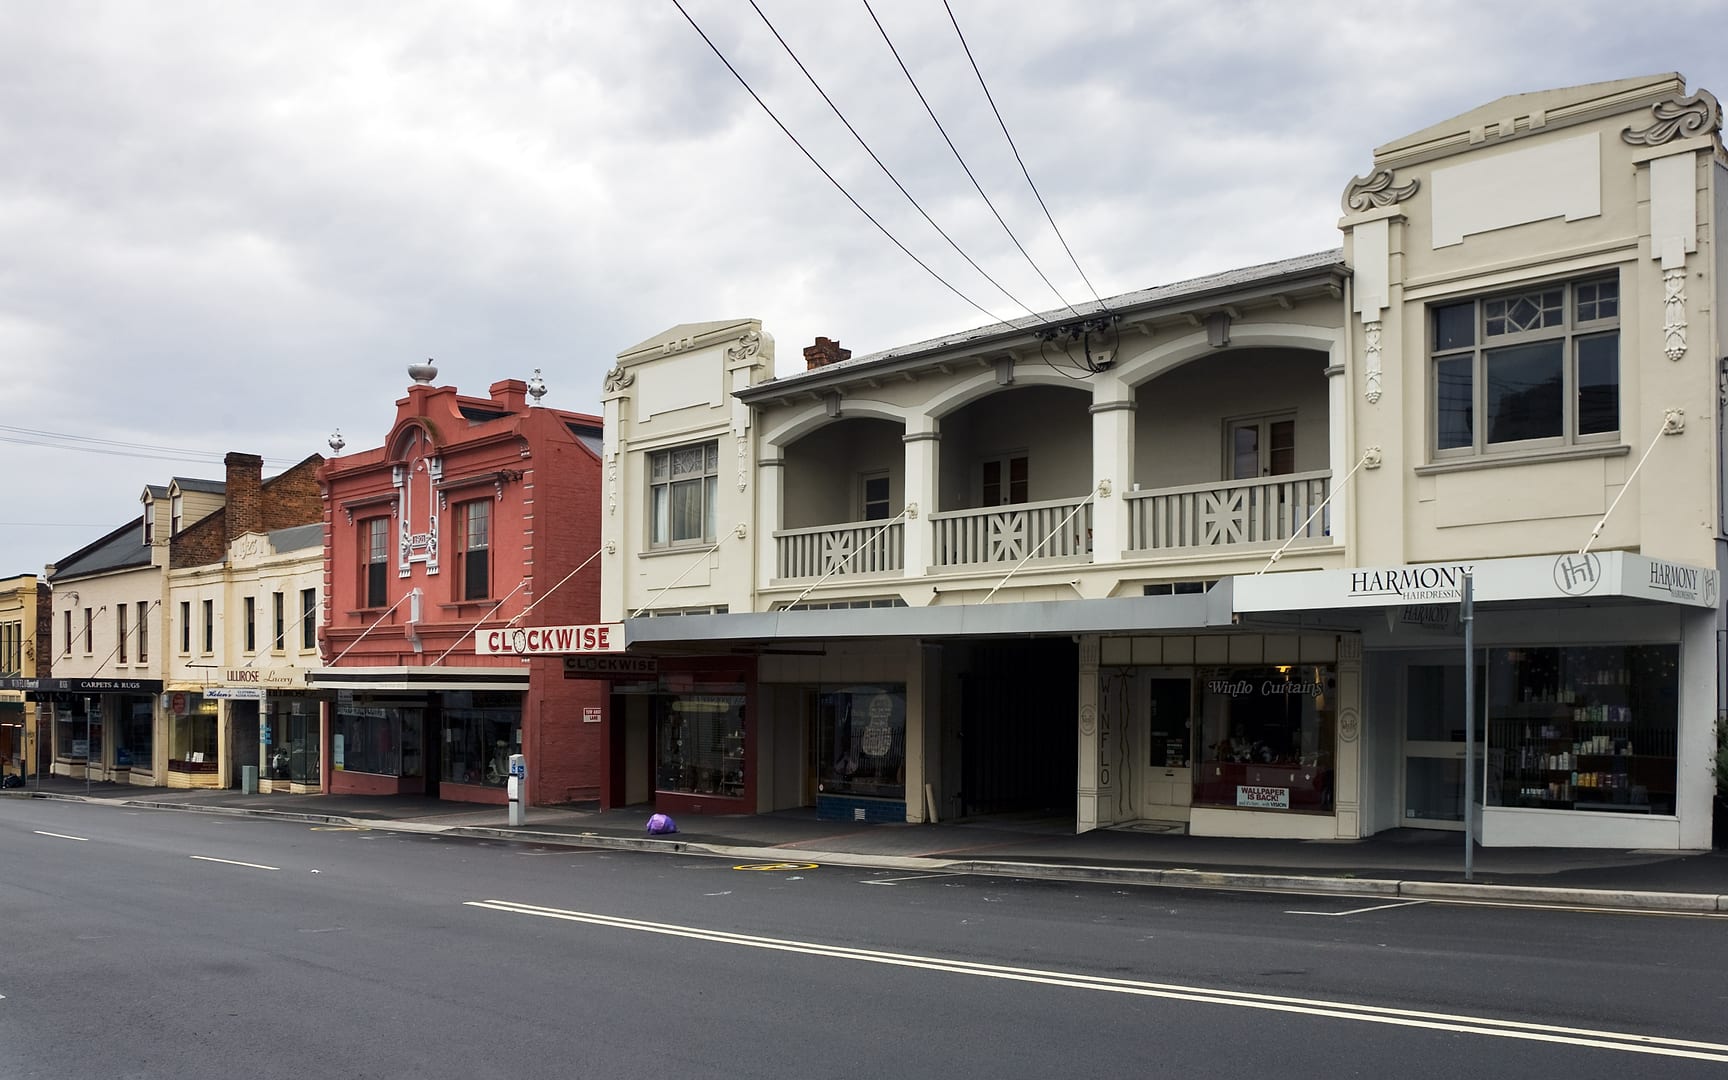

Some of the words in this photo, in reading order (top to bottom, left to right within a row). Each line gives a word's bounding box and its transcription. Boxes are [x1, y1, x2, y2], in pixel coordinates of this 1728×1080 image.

[1650, 561, 1698, 591] HARMONY
[1403, 589, 1462, 600] HAIRDRESSIN
[488, 627, 610, 653] CLOCKWISE
[565, 657, 656, 672] CLOCKWISE
[226, 670, 260, 683] LILLIROSE
[81, 681, 112, 689] CARPETS
[1208, 680, 1253, 697] Winflo
[1261, 680, 1322, 697] Curtains
[1100, 676, 1112, 785] WINFLO
[1241, 787, 1285, 796] WALLPAPER
[1256, 794, 1279, 802] BACK!
